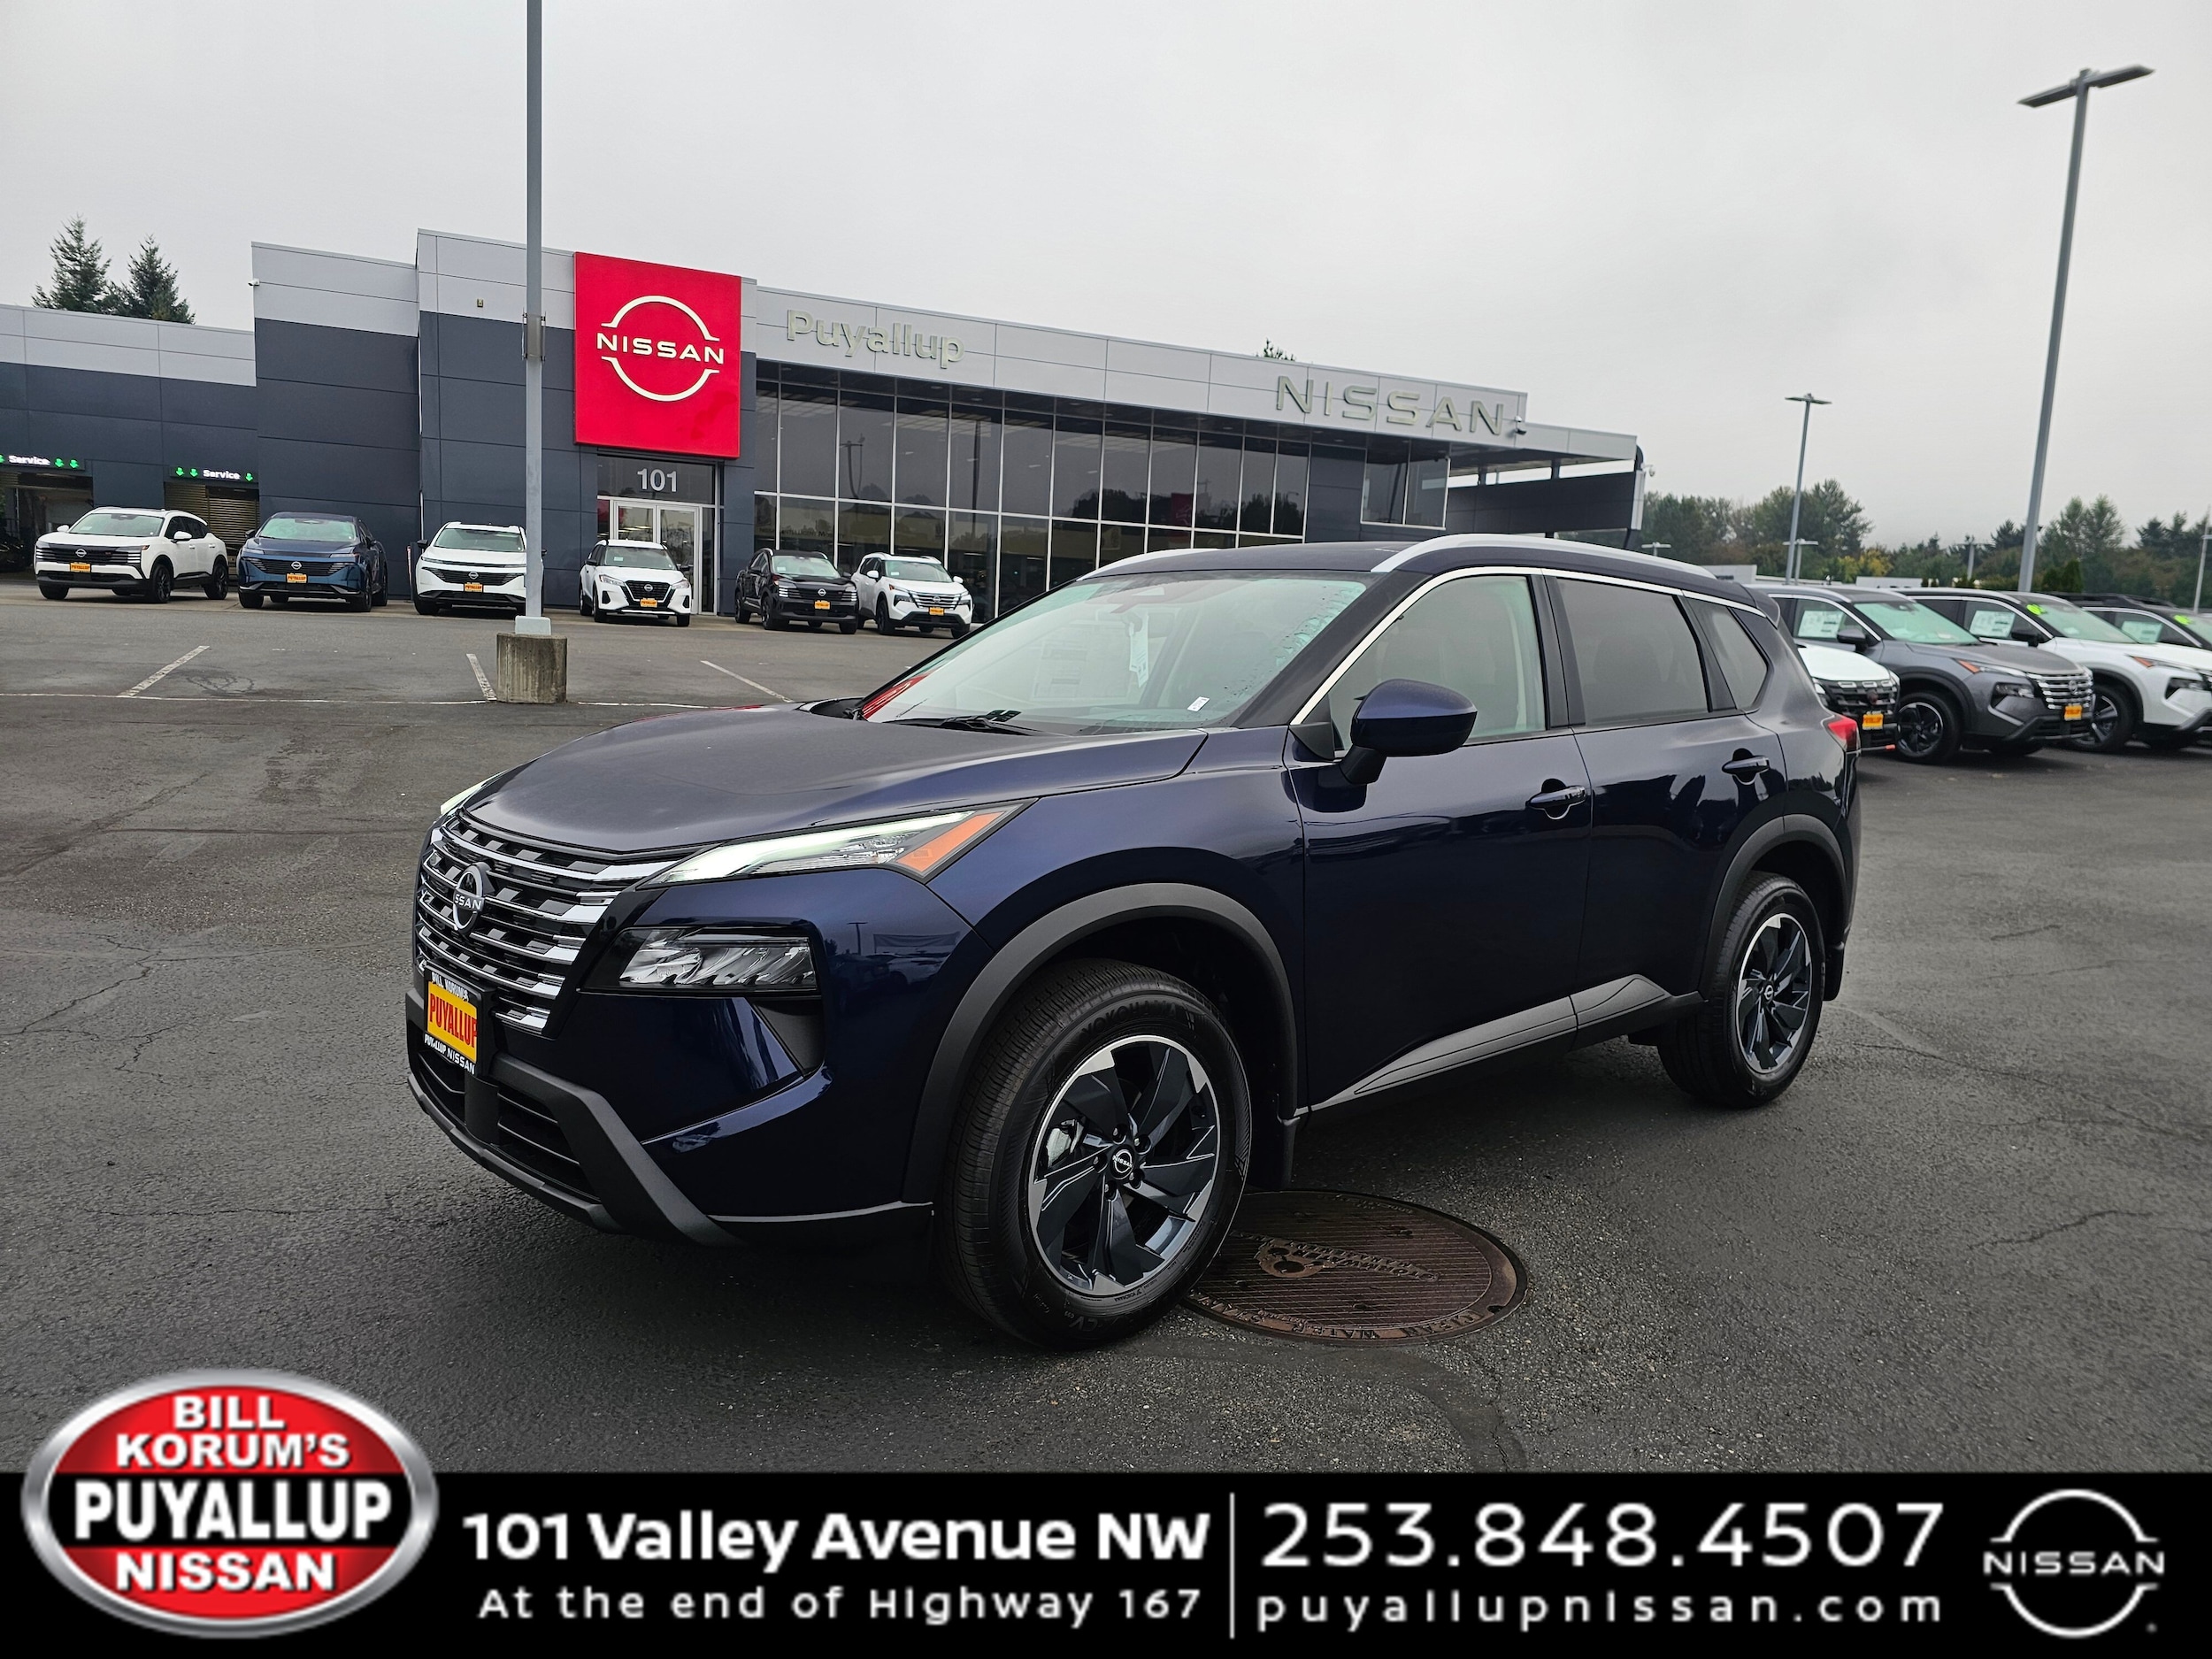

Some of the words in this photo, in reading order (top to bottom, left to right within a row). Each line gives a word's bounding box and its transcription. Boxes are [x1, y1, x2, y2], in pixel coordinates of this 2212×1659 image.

[597, 332, 725, 365] NISSAN
[787, 309, 965, 370] Puyallup
[1276, 375, 1505, 436] NISSAN
[9, 455, 50, 466] Service
[203, 469, 241, 480] Service
[637, 468, 678, 493] 101
[429, 993, 477, 1048] PUYALLUP
[447, 1047, 475, 1075] NISSAN
